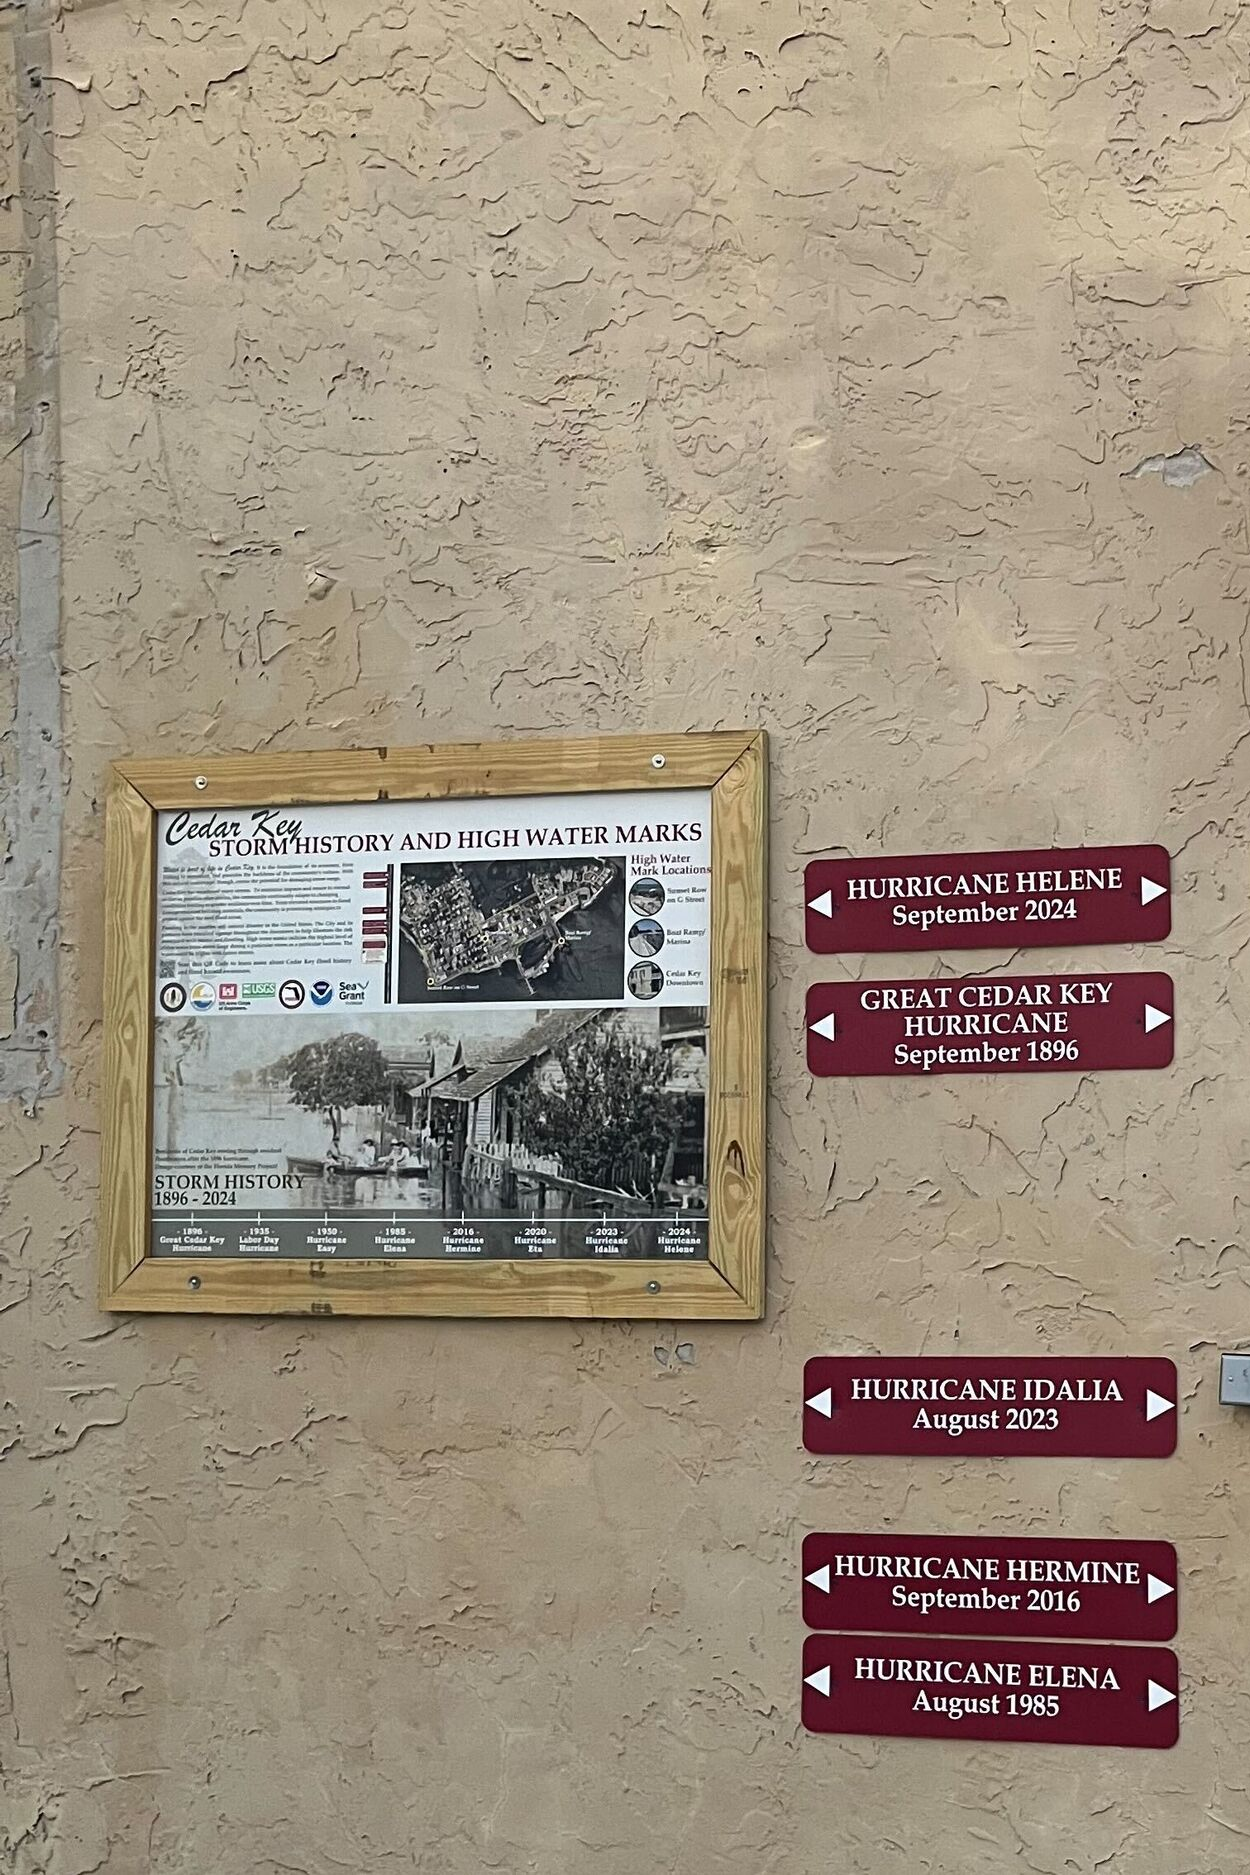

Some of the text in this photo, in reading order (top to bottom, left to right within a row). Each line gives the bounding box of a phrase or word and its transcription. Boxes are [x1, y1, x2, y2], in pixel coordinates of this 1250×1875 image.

[165, 810, 302, 846] Cedar Key
[209, 823, 702, 857] STORM HISTORY AND HIGH WATER MARKS
[631, 854, 690, 867] High Water
[631, 865, 712, 876] Mark Locations
[848, 868, 1122, 900] HURRICANE HELENE
[893, 899, 1076, 931] September 2024
[688, 970, 701, 978] Key
[252, 983, 275, 994] USGS
[339, 982, 357, 990] Sea
[339, 992, 365, 1000] Grant
[861, 983, 1112, 1009] GREAT CEDAR KEY
[904, 1012, 1067, 1036] HURRICANE
[895, 1040, 1078, 1070] September 1896
[155, 1175, 306, 1189] STORM HISTORY
[155, 1191, 188, 1205] 1896
[202, 1191, 236, 1205] 2024
[210, 1236, 225, 1245] Key
[264, 1236, 280, 1245] Day
[585, 1237, 628, 1245] Hurricane
[658, 1236, 701, 1244] Hurricane
[317, 1245, 336, 1253] Easy
[852, 1379, 1123, 1400] HURRICANE IDALIA
[913, 1408, 1058, 1436] August 2023
[835, 1555, 1139, 1584] HURRICANE HERMINE
[893, 1585, 1080, 1614] September 2016
[855, 1658, 1120, 1689] HURRICANE ELENA
[912, 1690, 1059, 1719] August 1985
